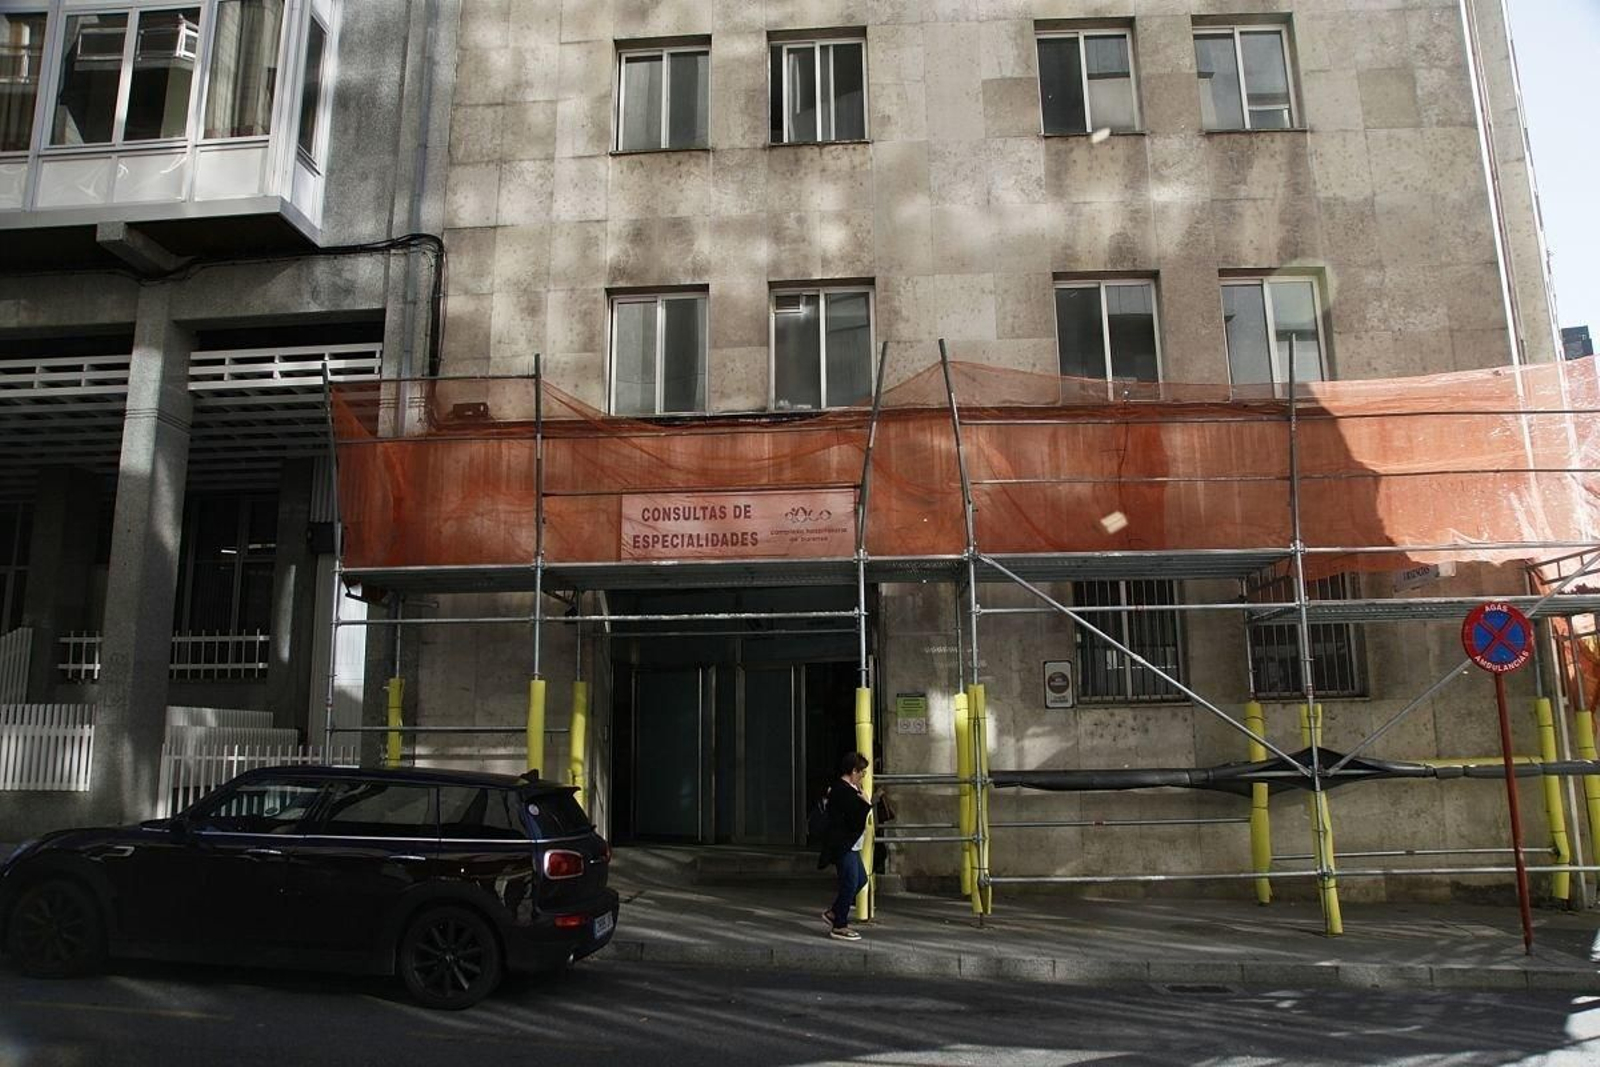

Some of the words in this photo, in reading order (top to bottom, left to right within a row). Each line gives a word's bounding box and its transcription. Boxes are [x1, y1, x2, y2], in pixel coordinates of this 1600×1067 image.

[641, 506, 728, 522] CONSULTAS
[733, 504, 752, 520] DE
[632, 531, 759, 549] ESPECIALIDADES
[1474, 650, 1529, 672] AMBULANCIAS
